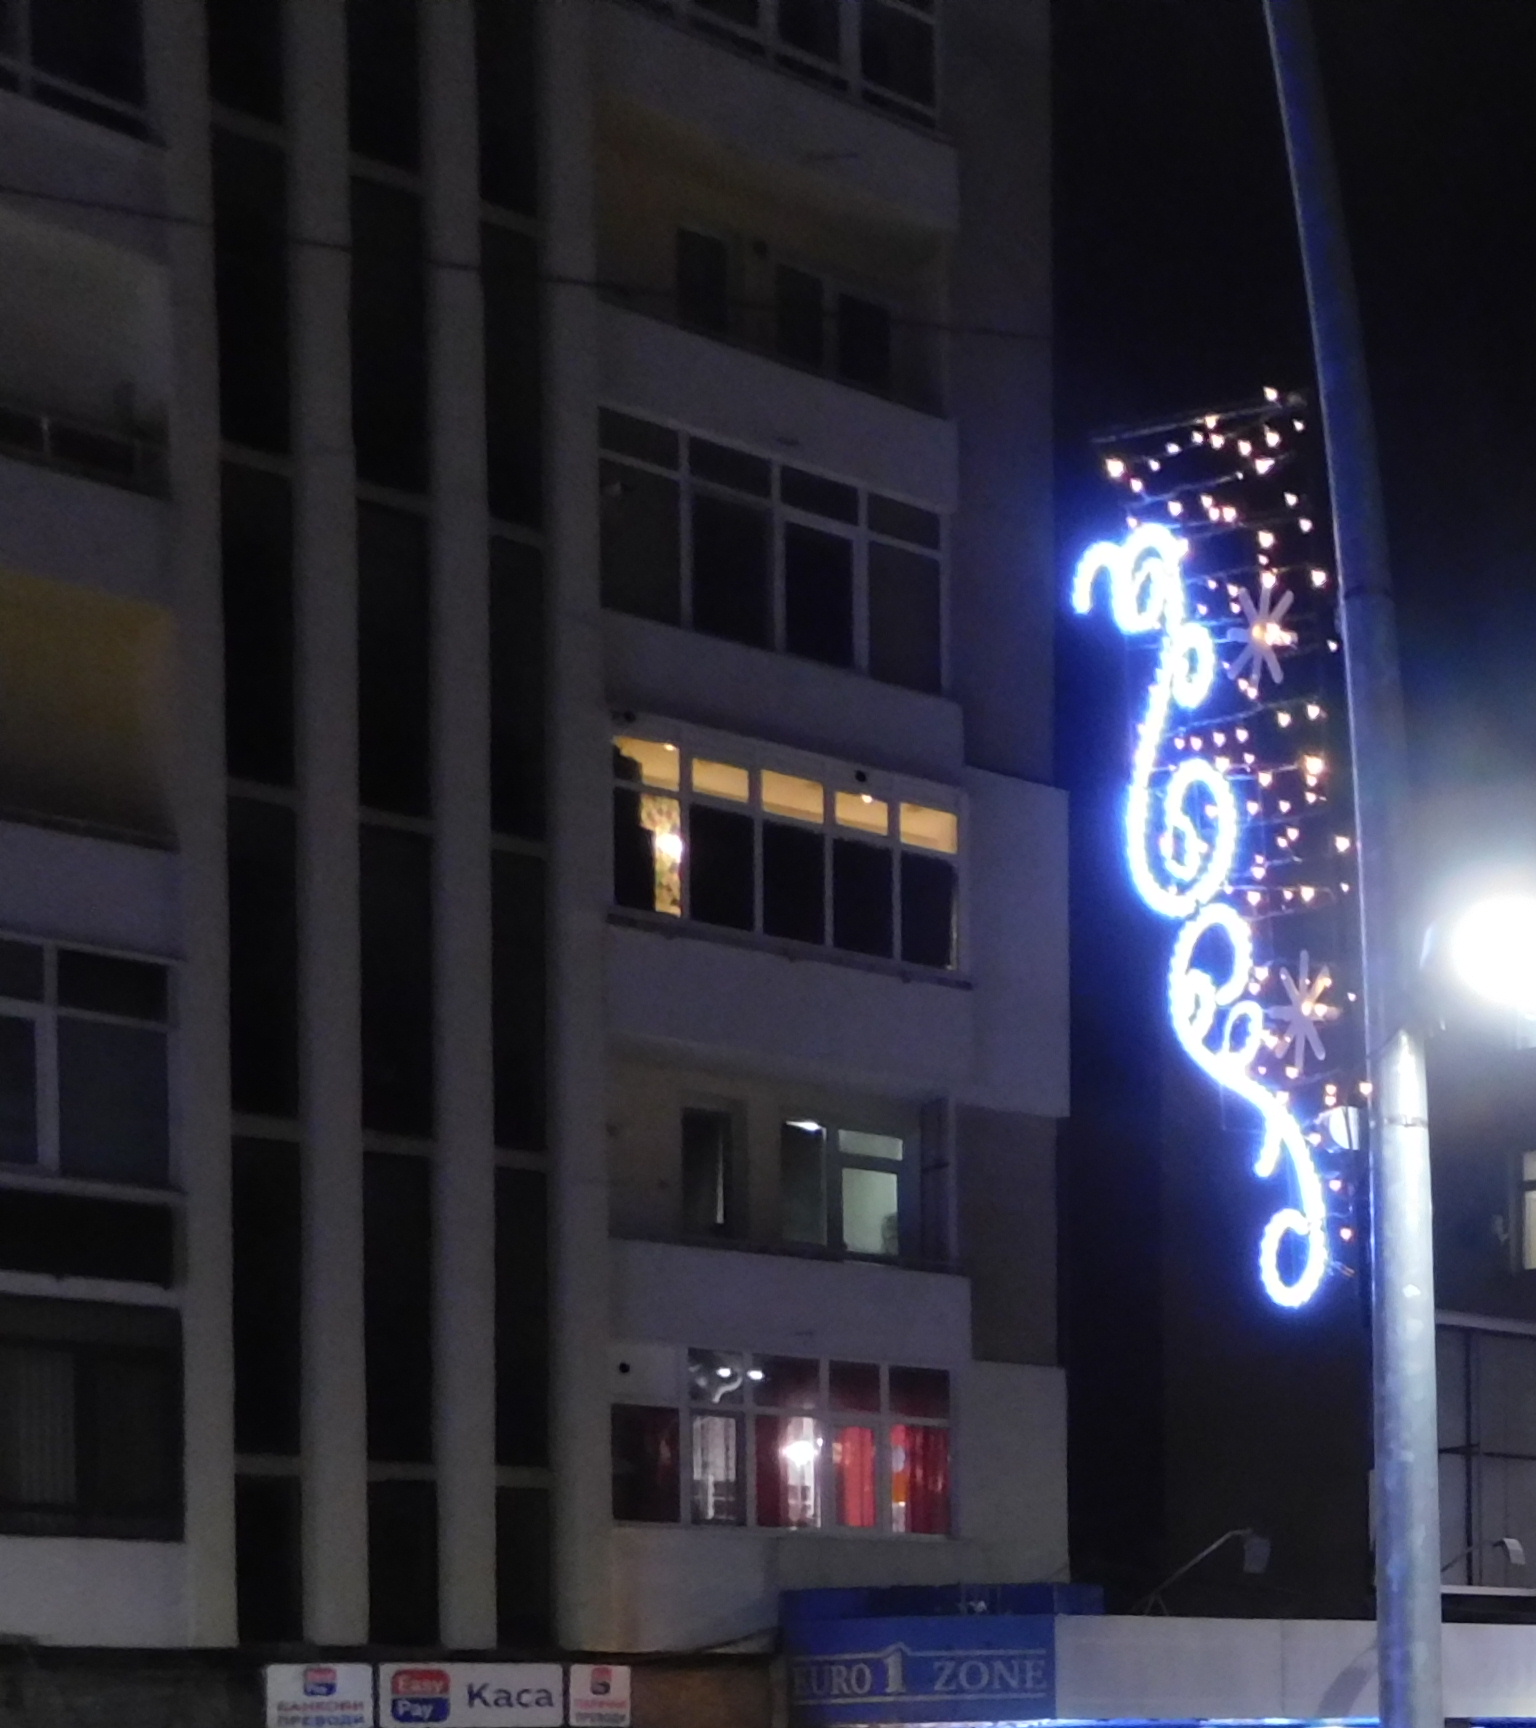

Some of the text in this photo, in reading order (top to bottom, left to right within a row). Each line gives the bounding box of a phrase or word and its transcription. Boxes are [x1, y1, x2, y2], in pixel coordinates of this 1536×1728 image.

[399, 1671, 444, 1696] Easy
[794, 1662, 873, 1696] EURO
[933, 1658, 1047, 1693] ZONE
[466, 1682, 554, 1709] Каса
[399, 1699, 434, 1721] Pay
